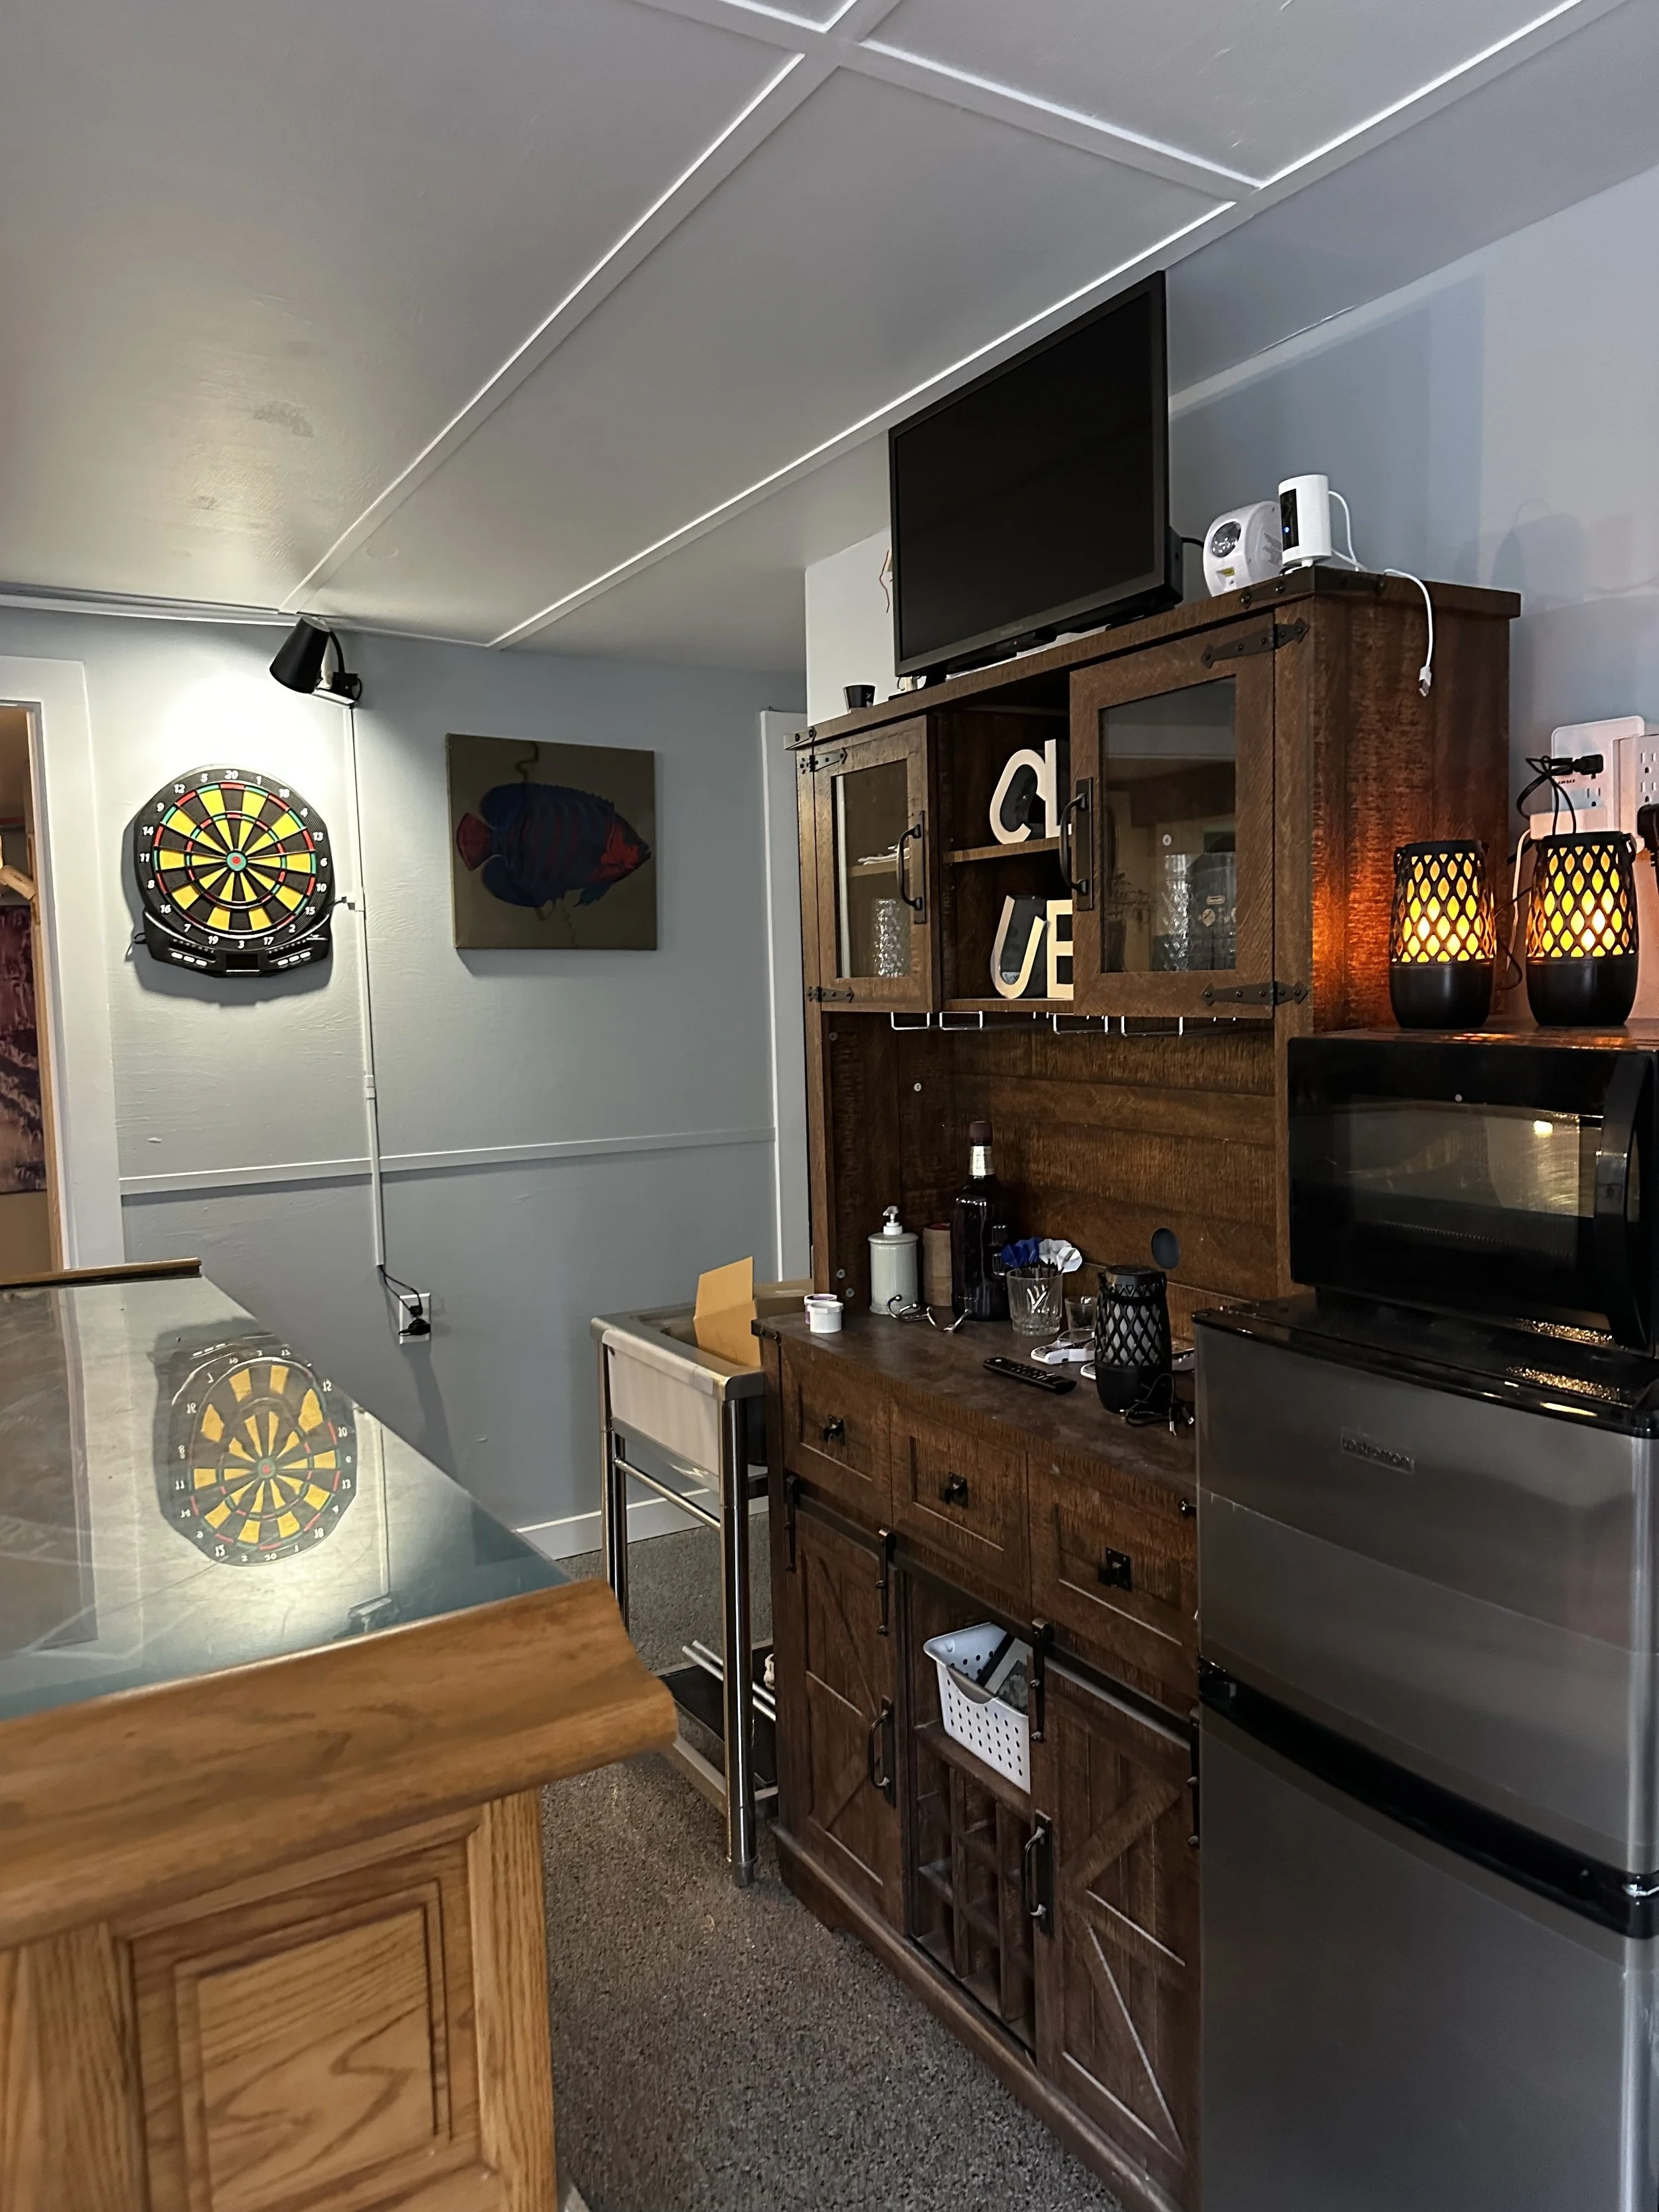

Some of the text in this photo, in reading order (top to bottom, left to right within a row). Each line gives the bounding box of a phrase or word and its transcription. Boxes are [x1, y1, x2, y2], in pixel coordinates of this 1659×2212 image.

[225, 770, 238, 779] 20
[256, 776, 261, 785] 1
[174, 784, 185, 793] 12
[300, 808, 308, 816] 4
[143, 826, 153, 835] 14
[140, 853, 150, 862] 11
[147, 880, 155, 889] 8
